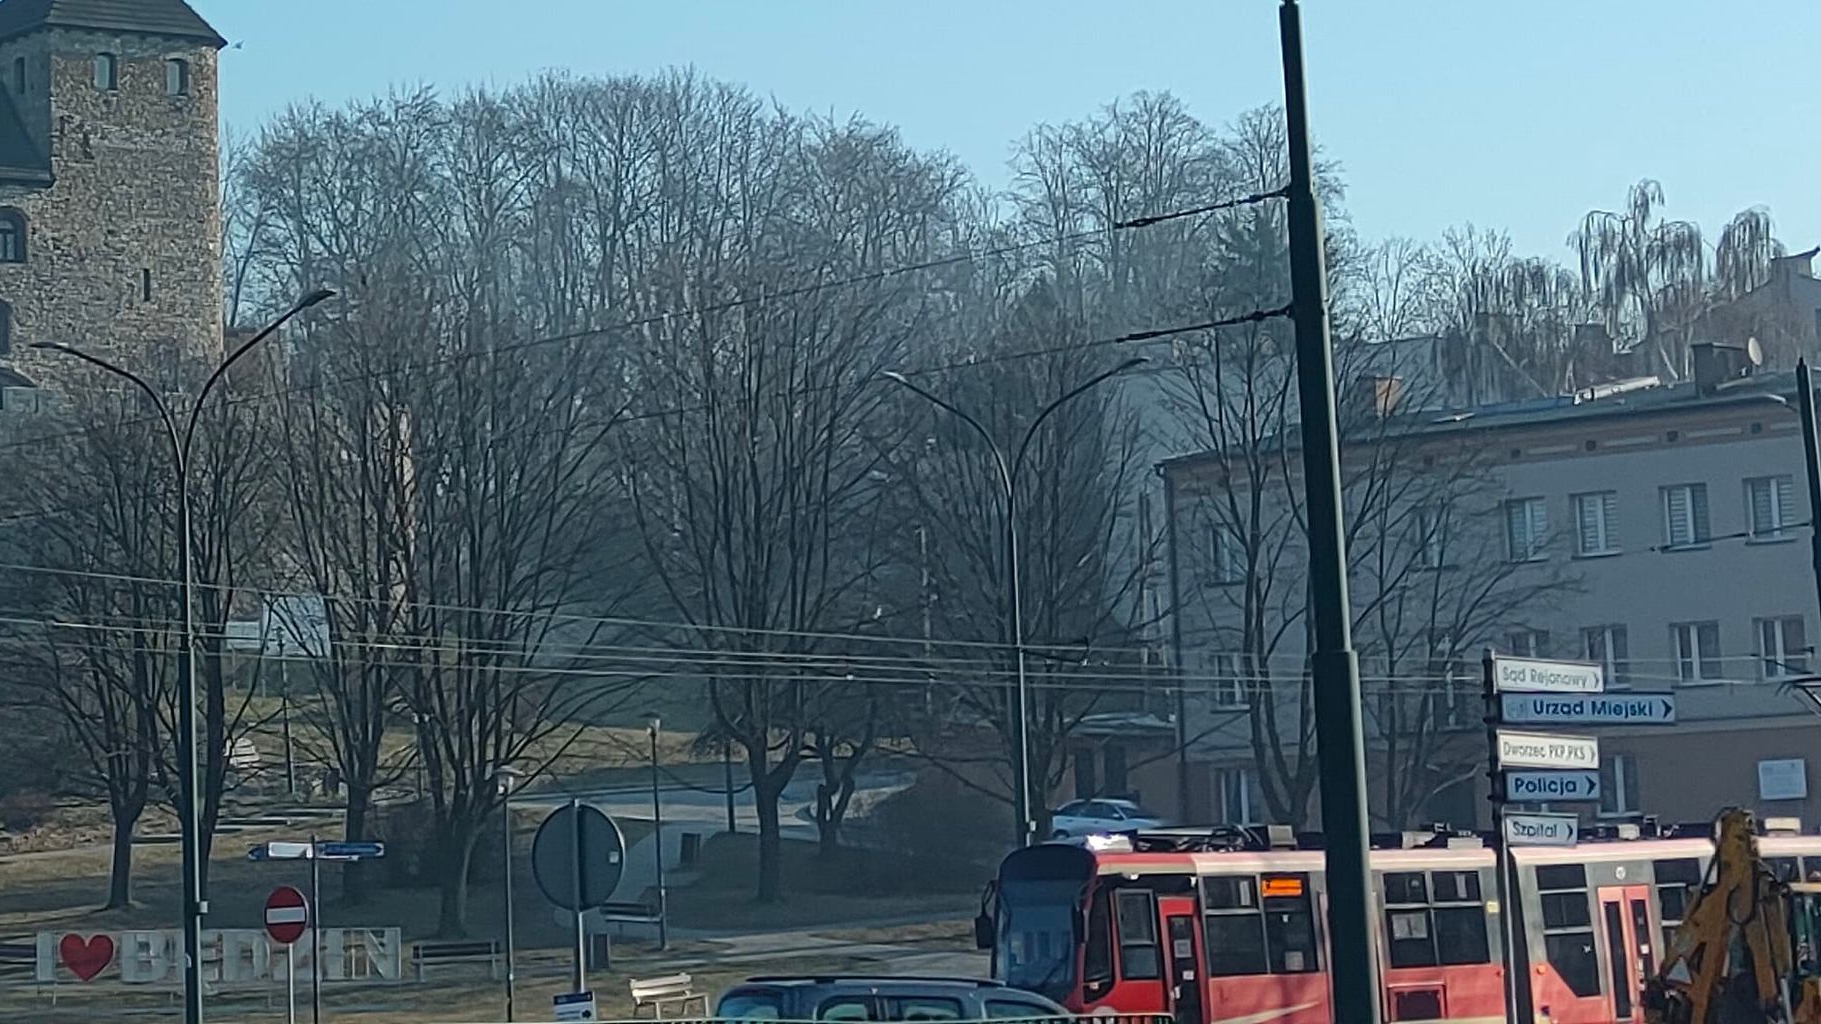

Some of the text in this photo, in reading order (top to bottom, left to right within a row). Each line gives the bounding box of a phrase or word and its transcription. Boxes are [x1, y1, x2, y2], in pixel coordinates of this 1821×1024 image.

[1531, 668, 1588, 689] Rejonowy
[1591, 700, 1653, 718] Miejski
[1503, 741, 1546, 759] Dworzec
[1514, 777, 1577, 796] Policja
[1512, 821, 1558, 840] Szpital
